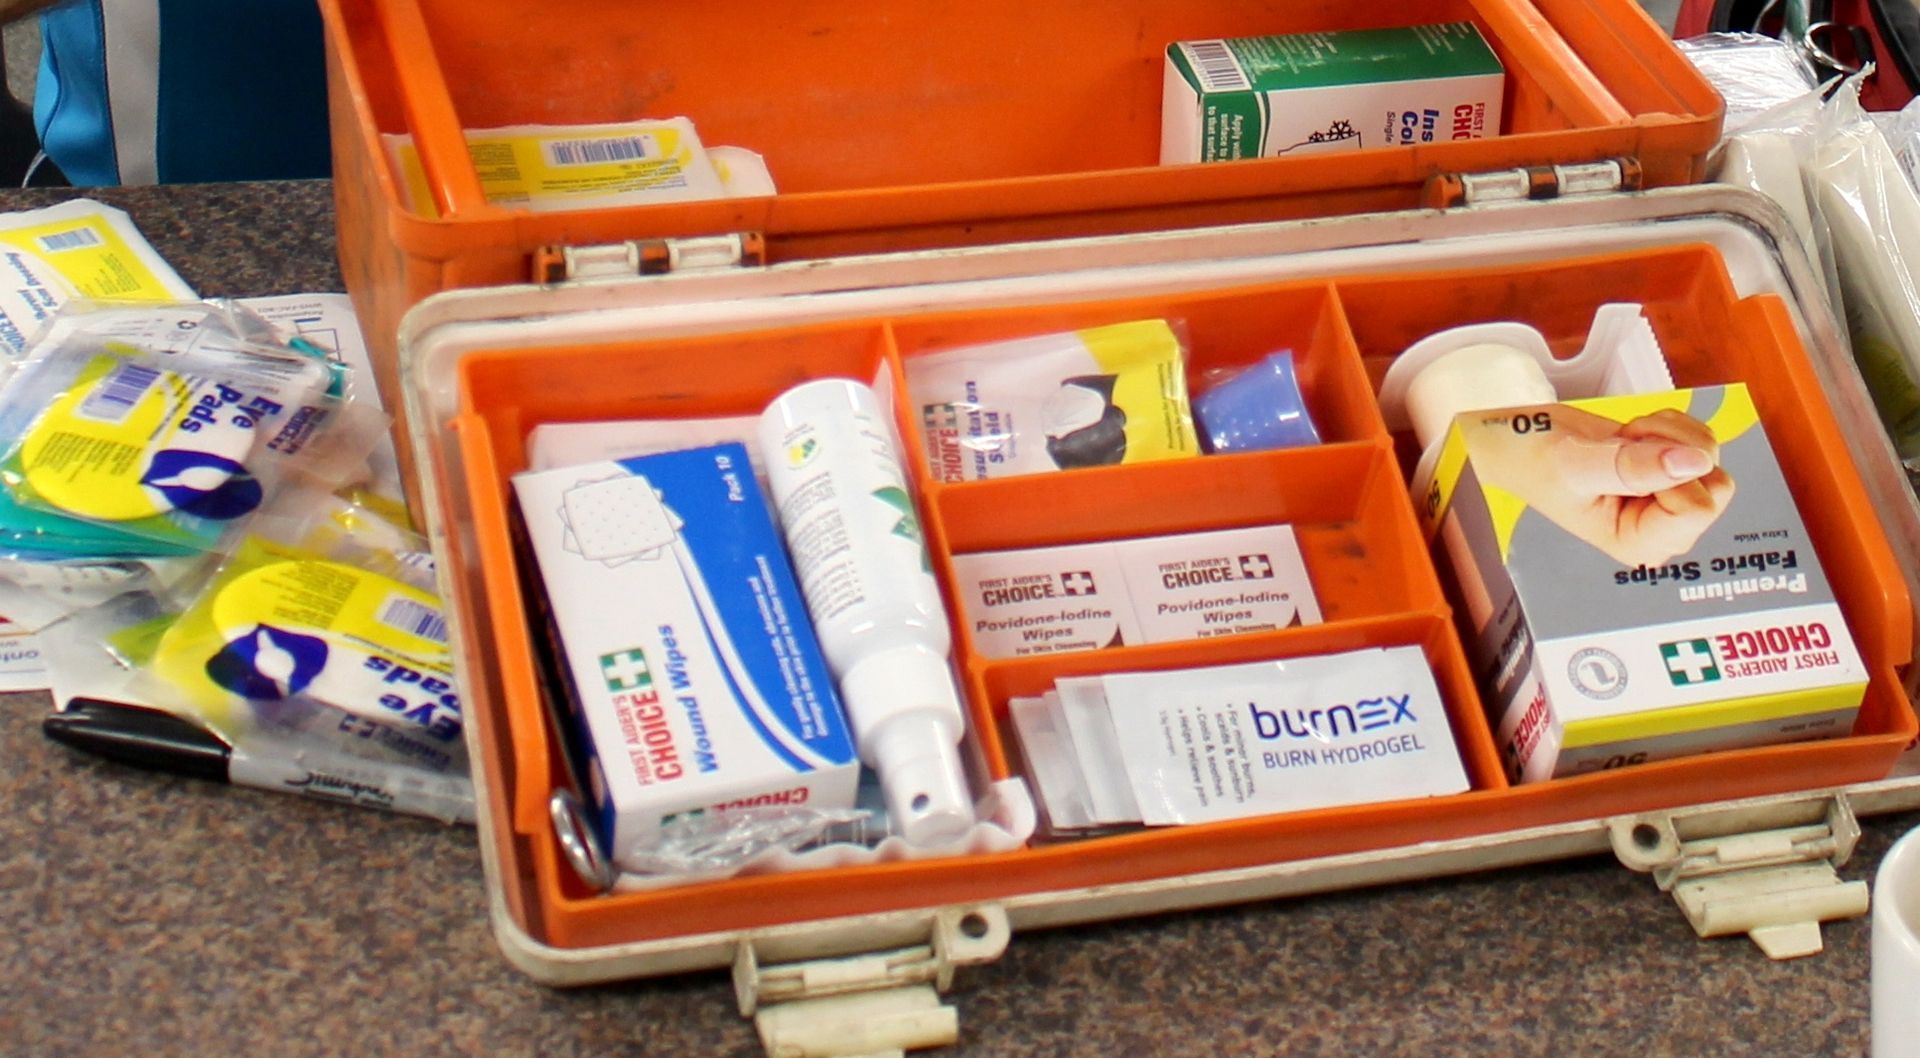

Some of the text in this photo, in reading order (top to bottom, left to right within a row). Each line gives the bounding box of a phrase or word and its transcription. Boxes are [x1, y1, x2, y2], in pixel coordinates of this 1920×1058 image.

[1207, 106, 1216, 116] to
[1207, 117, 1218, 135] that
[1231, 114, 1244, 139] Apply
[1385, 111, 1396, 143] Single
[1421, 108, 1440, 143] Ins
[1473, 102, 1485, 130] FIRST
[1220, 113, 1230, 147] surface
[179, 383, 244, 433] Pads
[231, 396, 284, 429] Eye
[1511, 411, 1552, 435] 50
[715, 455, 744, 501] Pack 10
[1733, 529, 1789, 542] Extra Wide
[1158, 557, 1231, 573] FIRST AIDER'S
[1162, 567, 1235, 590] CHOICE
[1614, 550, 1798, 586] Fabric Strips
[979, 574, 1053, 590] FIRST AIDER'S
[982, 583, 1056, 607] CHOICE
[1679, 572, 1808, 602] Premium
[1157, 591, 1290, 615] Povidone-Iodine
[1203, 610, 1253, 624] Wipes
[976, 608, 1112, 633] Povidone-Iodine
[1023, 627, 1074, 641] Wipes
[1715, 623, 1832, 661] CHOICE
[1724, 651, 1840, 679] FIRST AIDER'S
[658, 624, 718, 773] Wound Wipes
[378, 693, 461, 742] Eye
[612, 694, 653, 786] FIRST AIDER'S
[631, 690, 684, 782] CHOICE
[1179, 715, 1192, 744] Helps
[1188, 747, 1201, 783] relieve
[1229, 710, 1238, 726] For
[1234, 729, 1247, 760] minor
[1262, 733, 1426, 769] BURN HYDROGEL
[1196, 712, 1224, 798] Cools & soothes
[1215, 712, 1244, 804] scalds & sunburn
